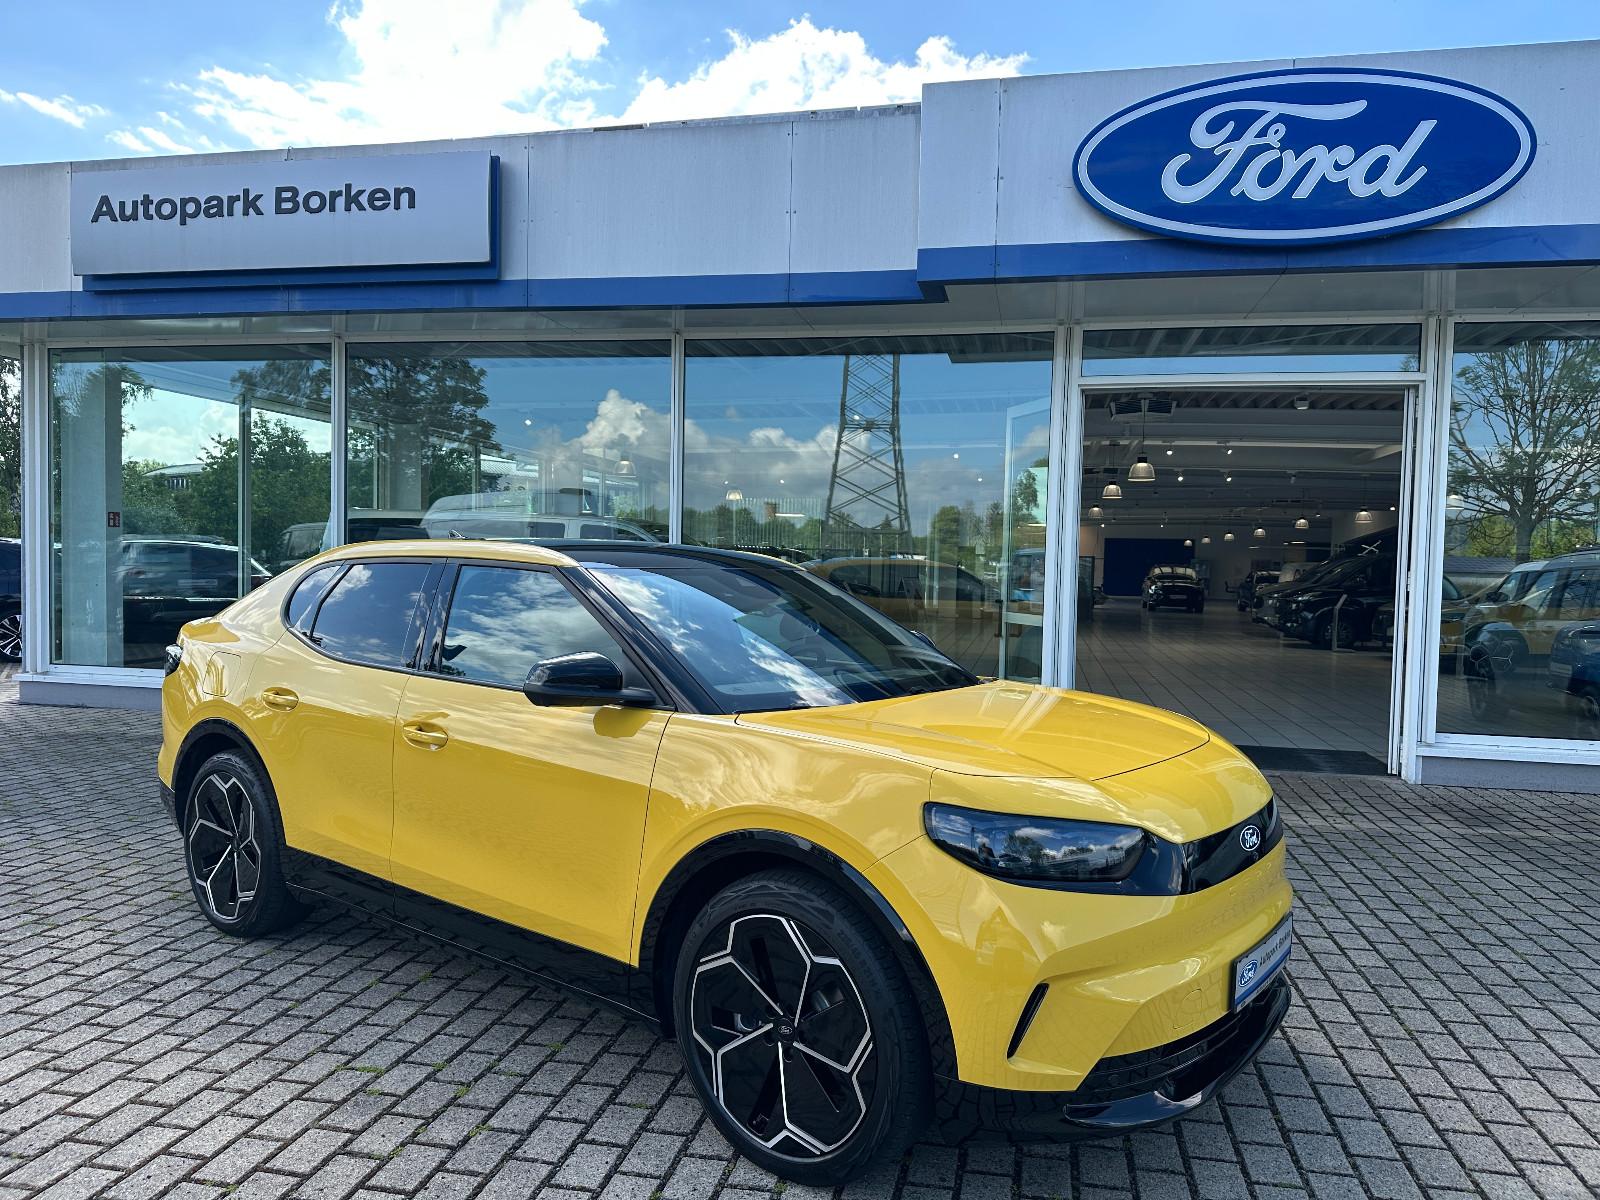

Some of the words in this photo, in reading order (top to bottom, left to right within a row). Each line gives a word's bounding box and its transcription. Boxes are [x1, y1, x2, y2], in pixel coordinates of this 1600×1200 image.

[1161, 99, 1437, 204] Ford
[91, 188, 264, 226] Autopark
[274, 183, 416, 215] Borken
